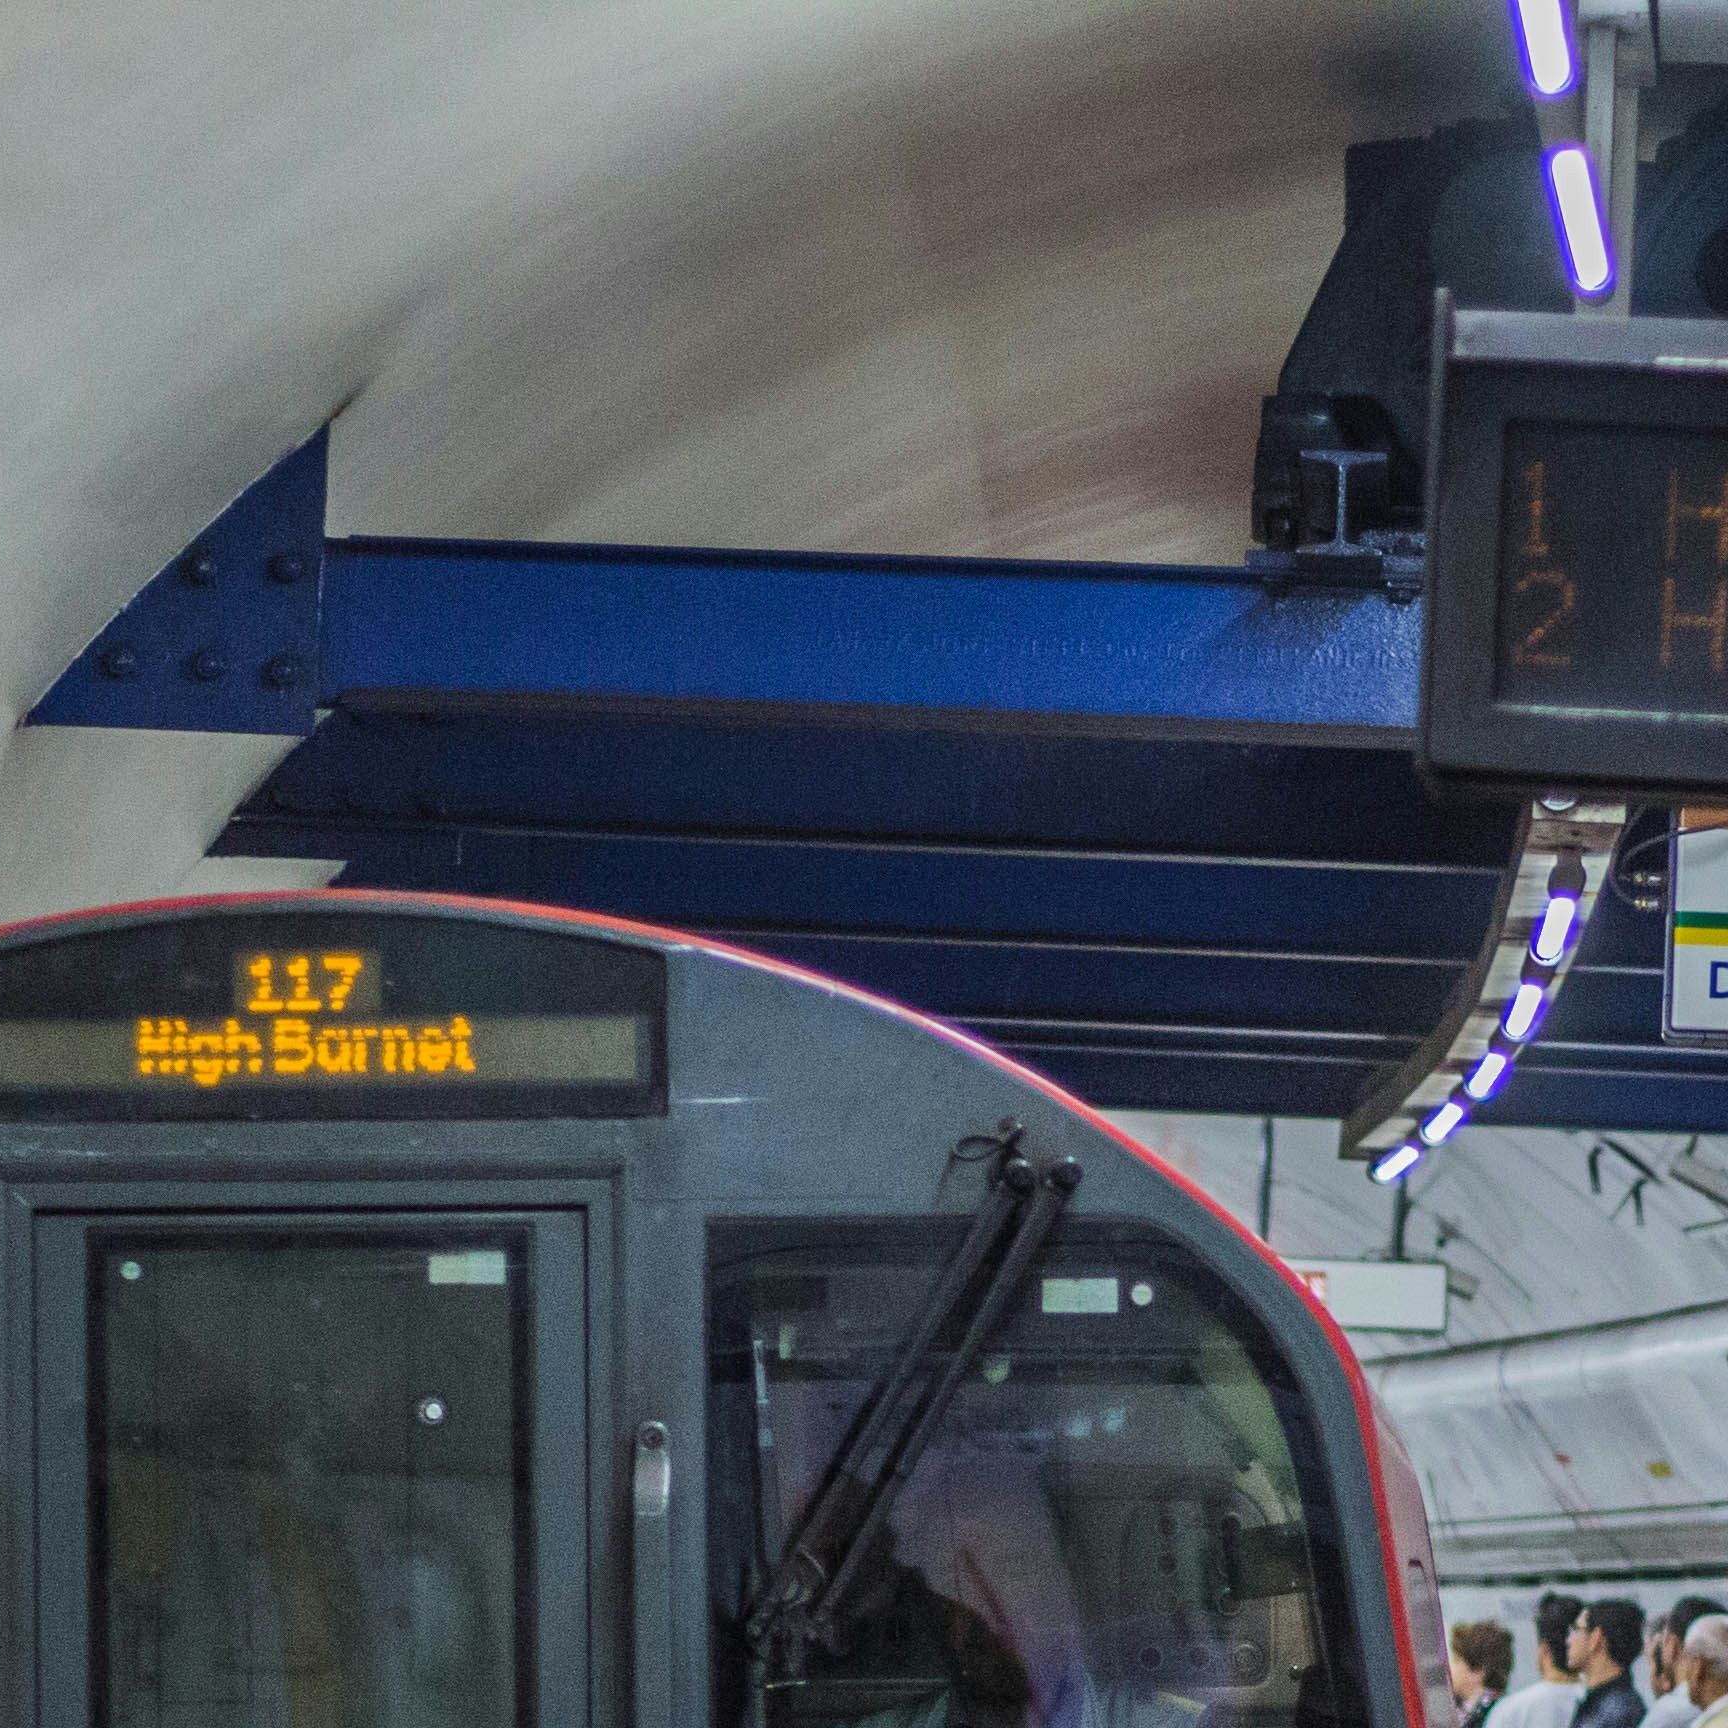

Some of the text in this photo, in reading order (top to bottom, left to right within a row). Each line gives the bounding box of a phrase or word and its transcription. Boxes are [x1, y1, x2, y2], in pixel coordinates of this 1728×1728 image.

[1521, 461, 1548, 556] 1
[1513, 569, 1575, 668] 2
[248, 955, 362, 1013] 117
[138, 1015, 477, 1086] High Barnet
